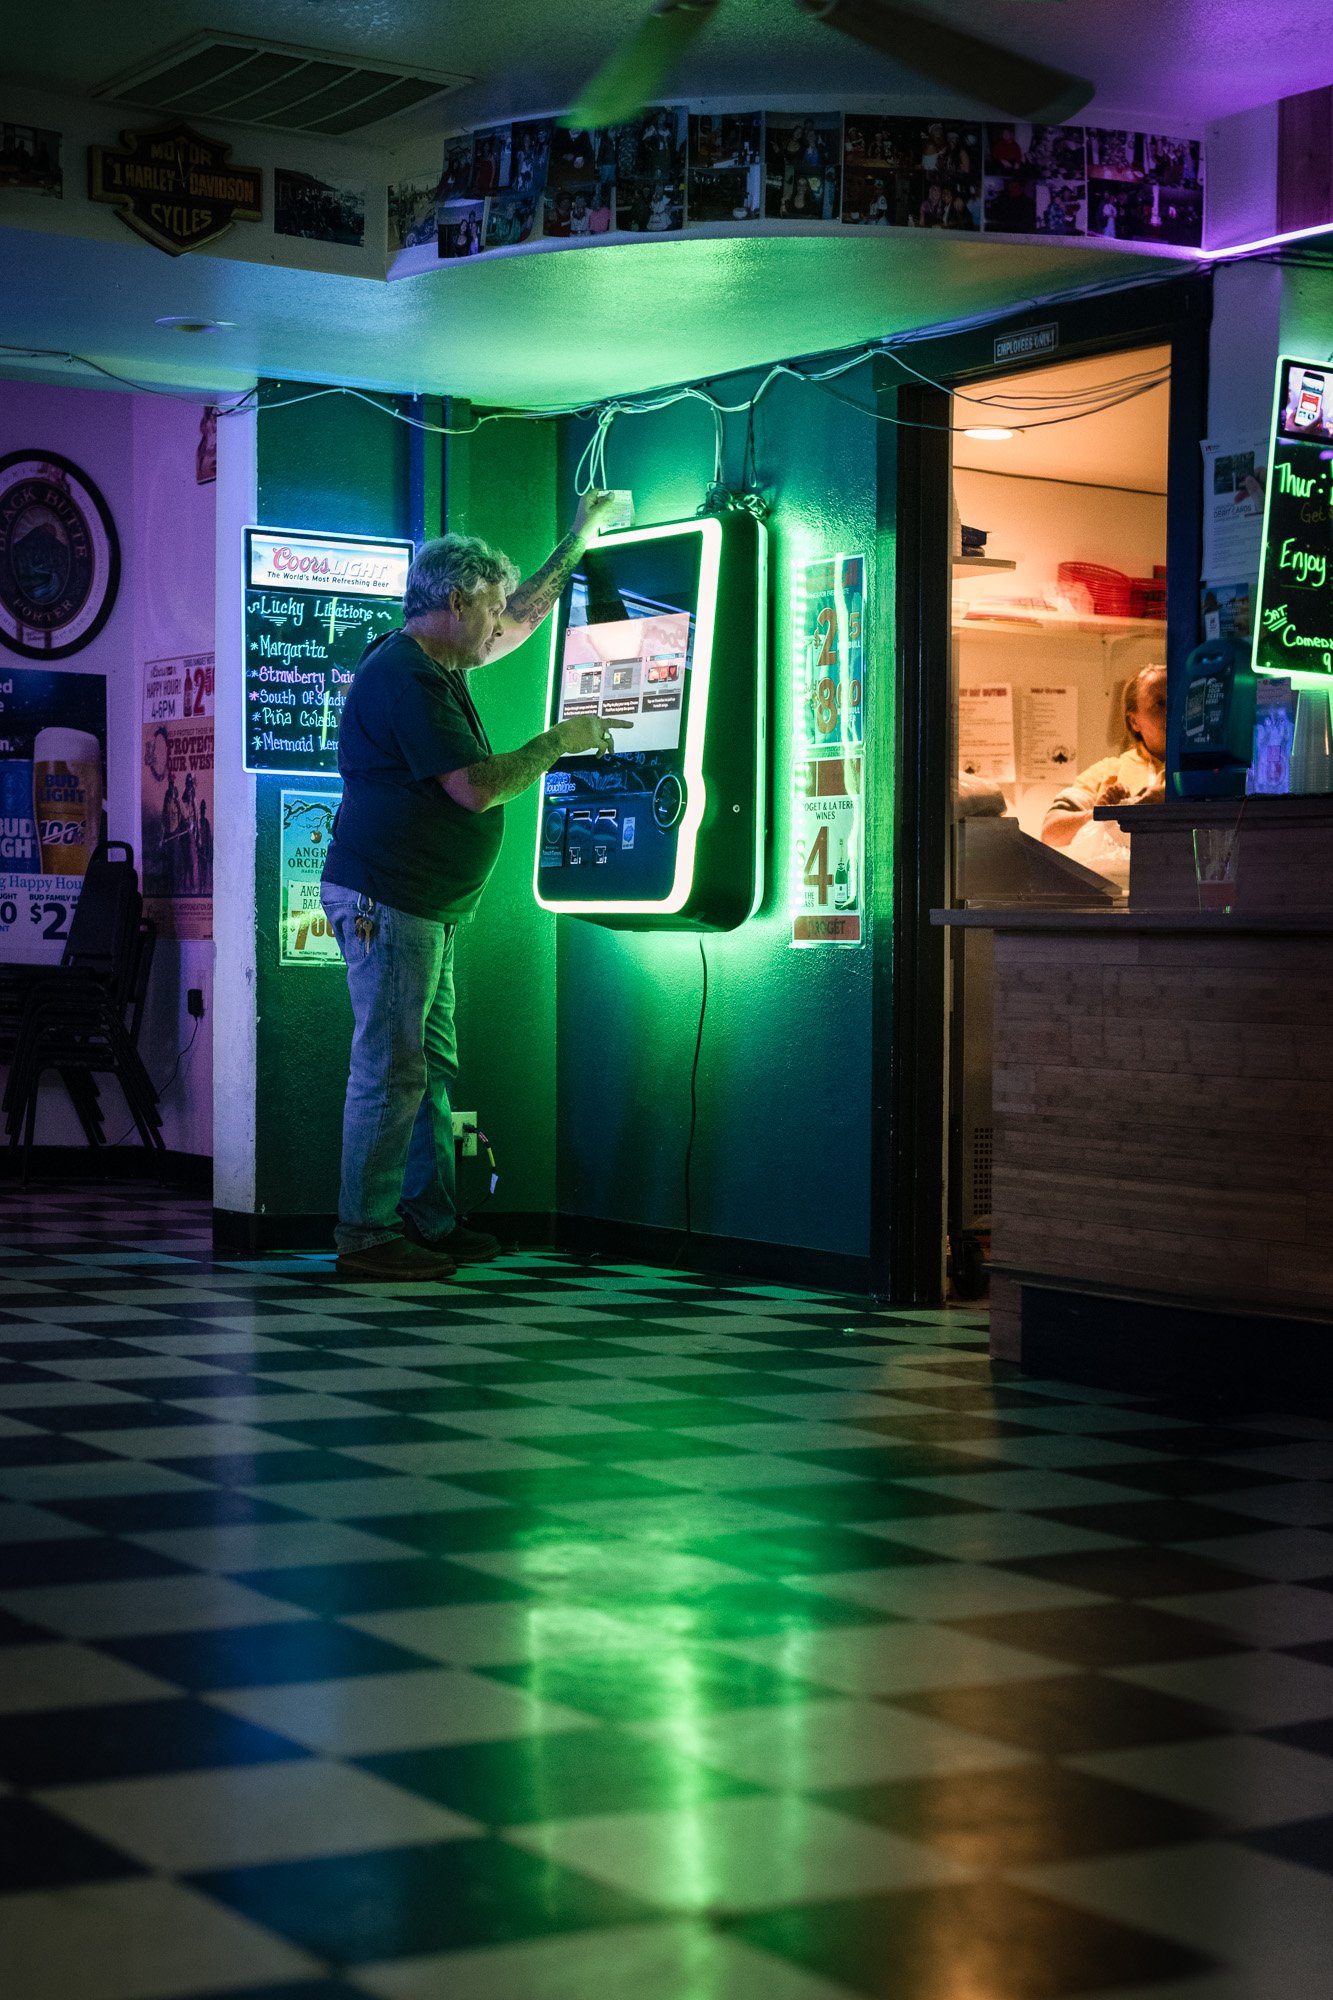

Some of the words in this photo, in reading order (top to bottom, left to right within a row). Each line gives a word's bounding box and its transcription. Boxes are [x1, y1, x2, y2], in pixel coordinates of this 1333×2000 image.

[150, 136, 213, 167] MOTOR
[125, 163, 176, 192] HARLEY
[189, 171, 255, 203] DAVIDSON
[151, 204, 213, 237] CYCLES
[997, 336, 1033, 358] EMPLOYEES
[1275, 462, 1327, 498] Thur:
[44, 490, 88, 558] BUTTE
[272, 546, 330, 574] Coors
[329, 558, 389, 579] LIGHT
[1280, 537, 1326, 587] Enjoy
[267, 571, 281, 579] The
[283, 572, 310, 581] World's
[312, 574, 330, 583] Most
[332, 577, 370, 588] Refreshing
[372, 580, 389, 588] Beer
[13, 599, 74, 623] PORTER
[261, 595, 305, 626] Lucky
[314, 600, 374, 620] Libations
[260, 634, 328, 665] Margarita
[258, 665, 325, 694] Strawberry
[260, 688, 296, 705] South
[302, 690, 315, 704] Of
[166, 735, 214, 755] PROTECT
[262, 731, 314, 752] Mermaid
[166, 755, 187, 771] OUR
[189, 753, 214, 771] WEST
[45, 774, 80, 788] BUD
[38, 788, 86, 803] LIGHT
[804, 801, 821, 811] OGET
[823, 801, 828, 811] &
[828, 800, 837, 810] LA
[815, 810, 836, 821] WINES
[288, 857, 325, 868] ORCHA
[295, 847, 327, 858] ANGR
[9, 875, 53, 892] Happy
[56, 876, 84, 890] Hou
[300, 885, 320, 897] ANG
[29, 893, 45, 901] BUD
[46, 894, 71, 902] FAMILY
